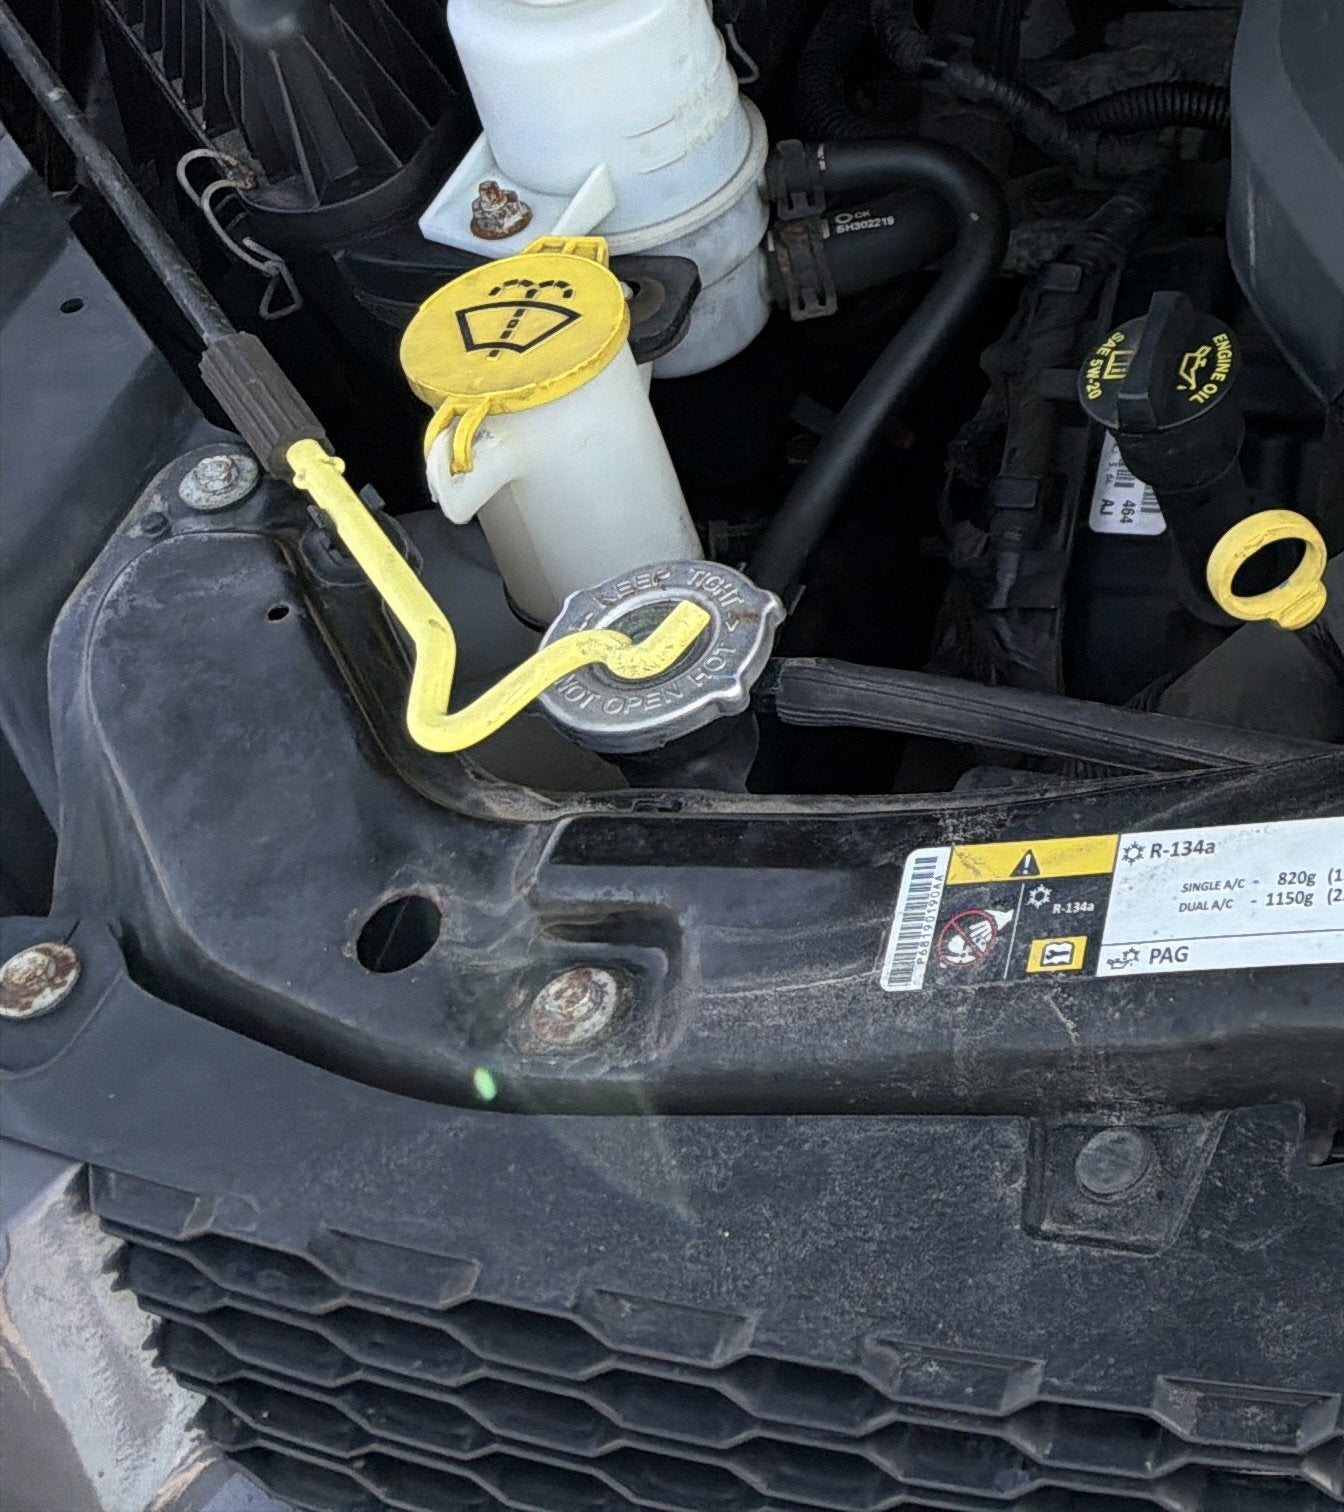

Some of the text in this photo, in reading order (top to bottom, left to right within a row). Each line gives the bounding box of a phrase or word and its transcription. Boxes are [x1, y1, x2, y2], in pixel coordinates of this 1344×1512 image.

[1085, 331, 1125, 400] SAE 5W-20
[1189, 333, 1233, 404] ENGINE OIL
[1099, 499, 1115, 516] AJ
[1120, 499, 1135, 524] 464
[597, 566, 744, 613] KEEP TIGHT
[604, 687, 686, 716] OPEN
[691, 643, 741, 687] HOT
[1149, 840, 1216, 858] R-134a
[1180, 881, 1221, 893] SINGLE
[1224, 878, 1245, 891] A/C
[1277, 871, 1316, 888] 820g
[1052, 902, 1095, 914] R-134a
[1178, 900, 1209, 913] DUAL
[1210, 898, 1233, 911] A/C
[1265, 891, 1314, 908] 1150g
[916, 874, 944, 965] P68190190AA
[1149, 945, 1189, 964] PAG
